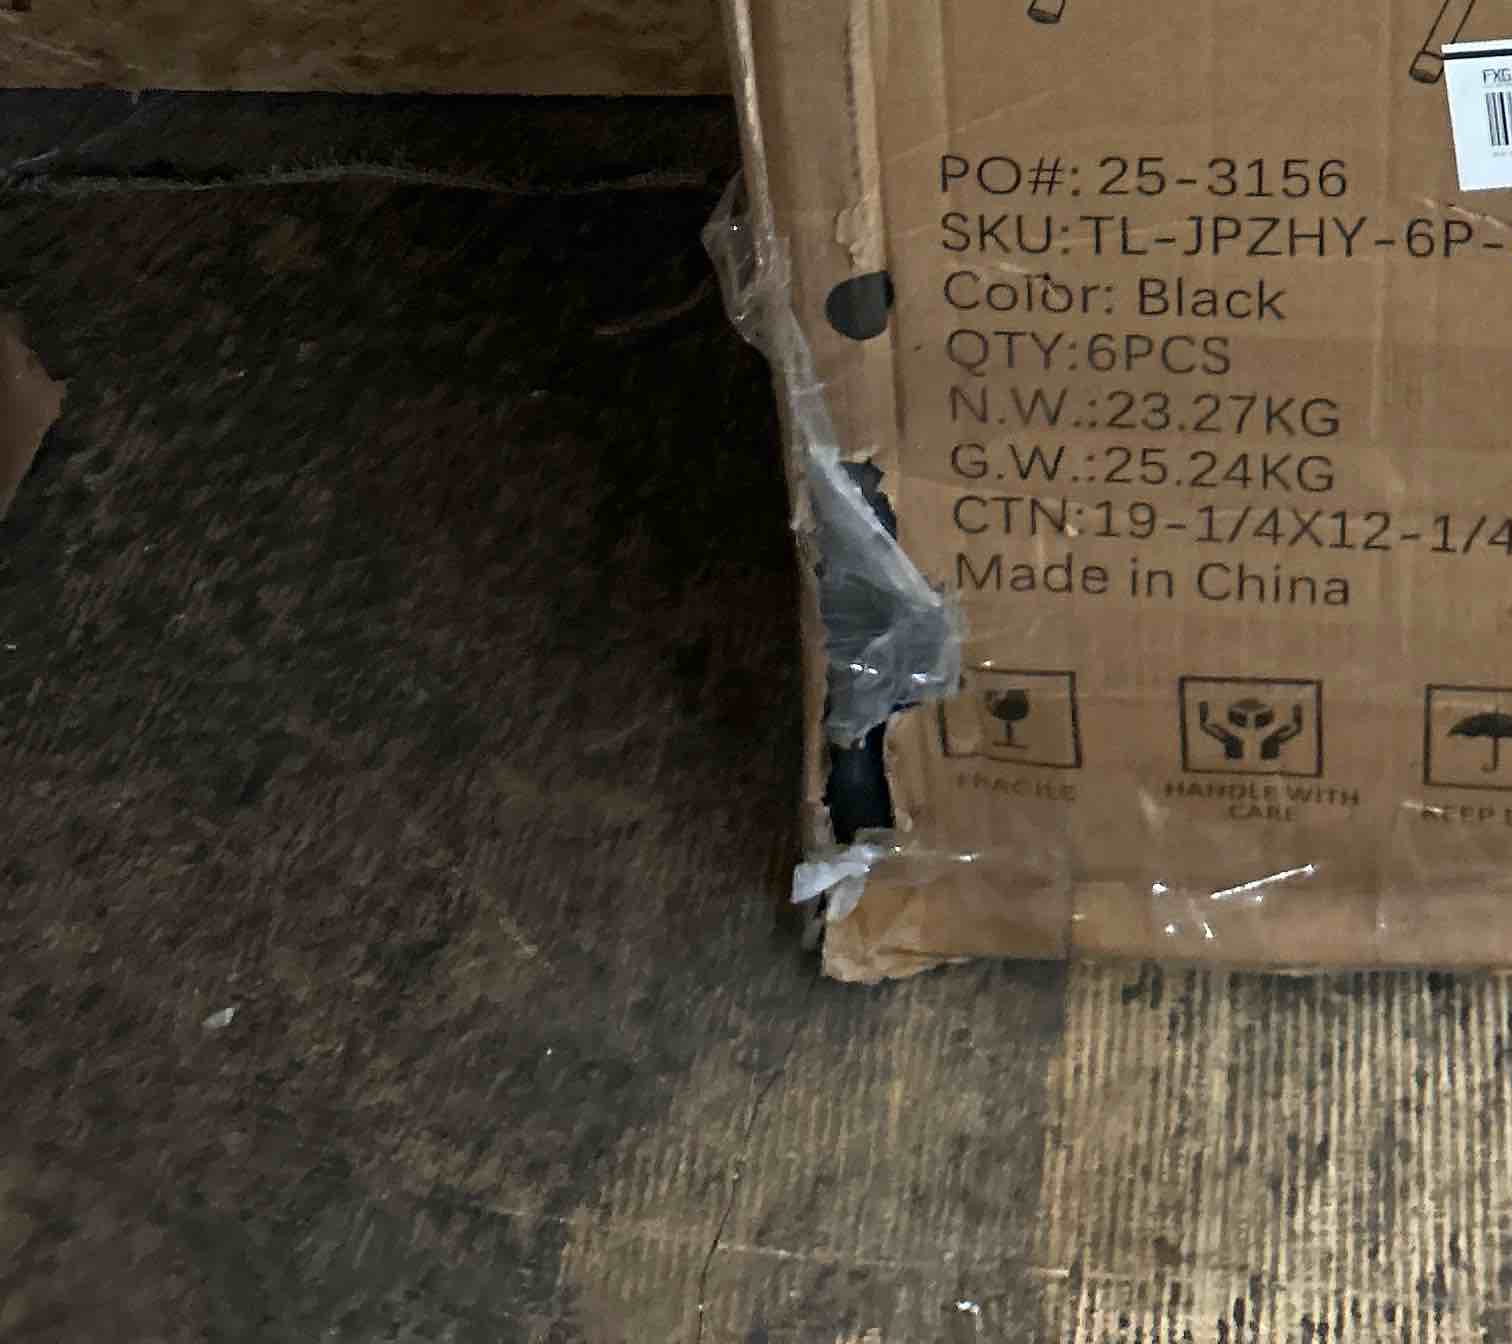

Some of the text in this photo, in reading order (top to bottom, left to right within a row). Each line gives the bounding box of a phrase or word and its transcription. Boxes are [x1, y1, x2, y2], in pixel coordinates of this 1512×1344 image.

[938, 154, 1349, 198] PO#: 25-3156
[942, 270, 1287, 321] Color: Black
[944, 328, 1232, 376] QTY:6PCS
[948, 384, 1341, 438] N.W.:23.27KG
[949, 443, 1336, 494] G.W.:25.24KG
[955, 554, 1352, 607] Made in China
[1165, 781, 1361, 808] HANDLE WITH
[1228, 803, 1298, 823] CARE
